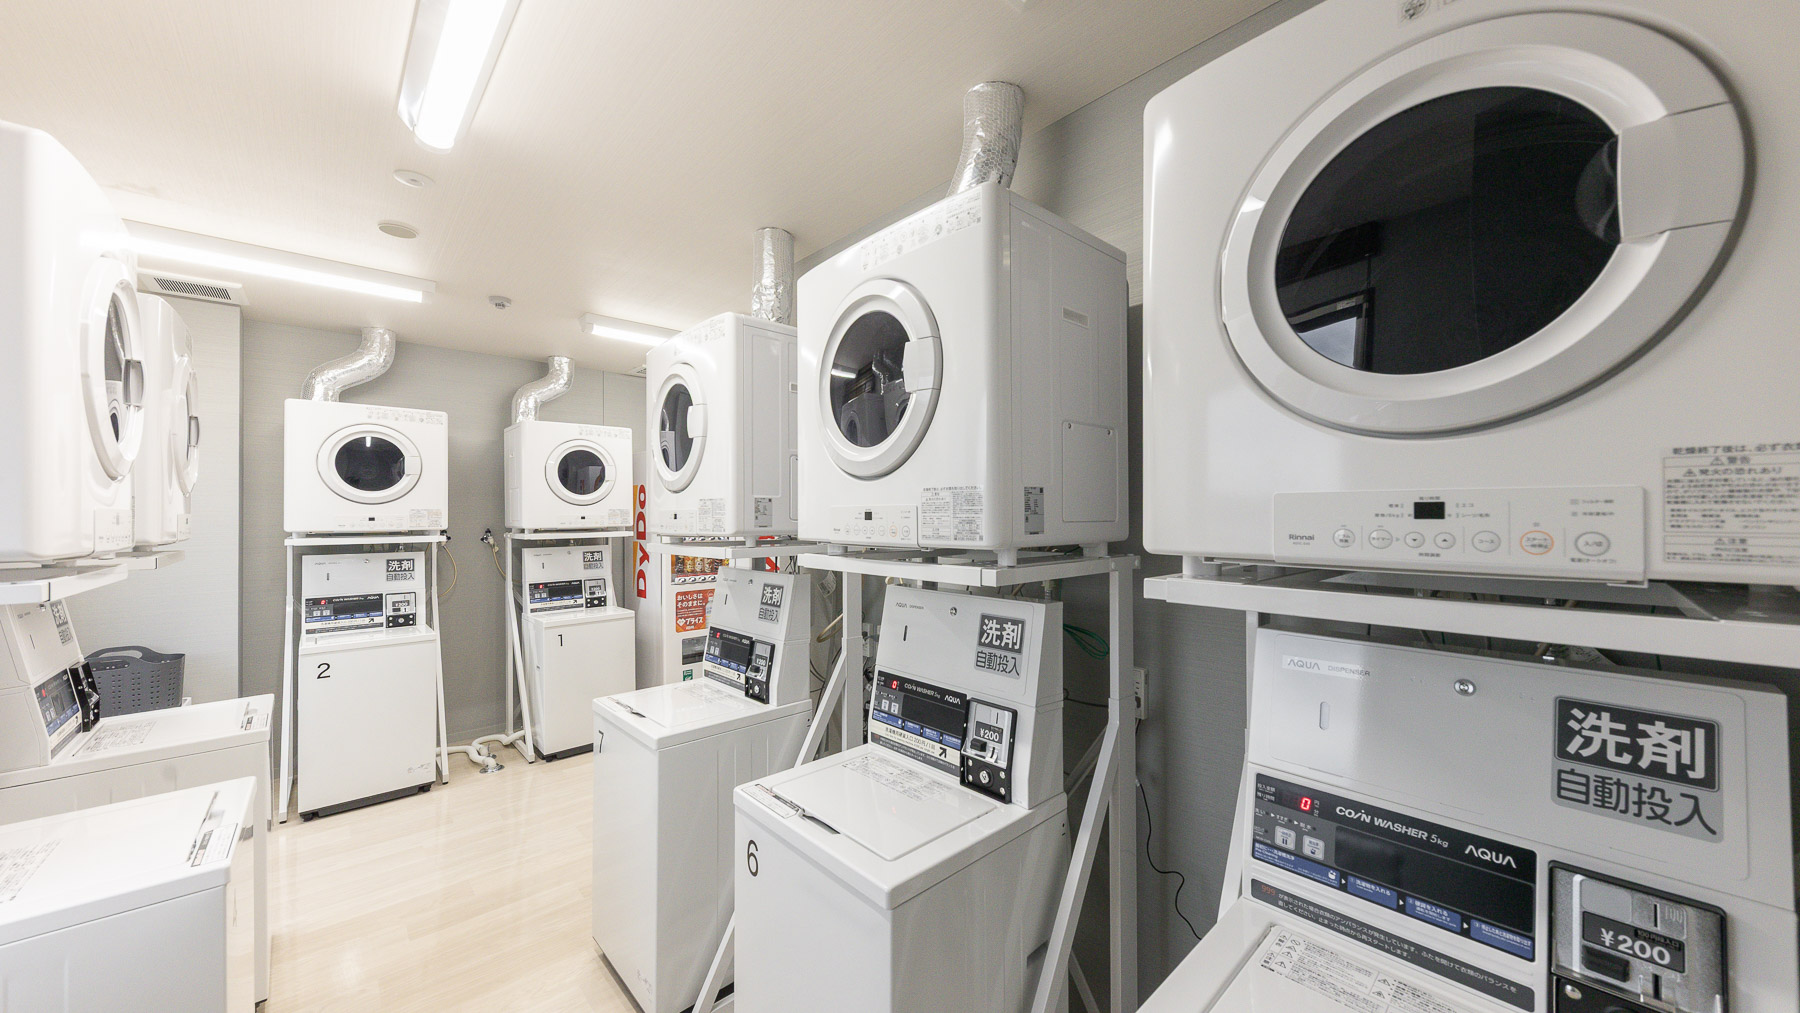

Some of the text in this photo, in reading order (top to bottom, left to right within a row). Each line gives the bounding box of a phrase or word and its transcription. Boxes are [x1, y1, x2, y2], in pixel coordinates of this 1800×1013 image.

[1288, 533, 1315, 541] Rinnai
[584, 551, 602, 561] 洗剤
[388, 560, 413, 571] 洗剤
[387, 573, 414, 581] 自動投入
[677, 593, 703, 601] おいしさは
[761, 586, 782, 606] 洗剤
[677, 600, 706, 608] そのままに。
[685, 616, 703, 625] プライス
[557, 633, 563, 646] 1
[980, 618, 1022, 650] 洗剤
[316, 662, 331, 680] 2
[975, 650, 1020, 677] 自動投入
[1287, 658, 1371, 677] AQUA DISPENSER
[891, 680, 898, 689] 0
[944, 694, 961, 705] AQUA
[598, 729, 604, 753] 7
[980, 727, 1000, 742] ¥200
[1565, 706, 1705, 779] 洗剤
[1300, 796, 1312, 811] 0
[1557, 768, 1717, 836] 自動投入
[1336, 806, 1449, 849] COIN WASHER 5kg
[747, 839, 759, 877] 6
[1465, 845, 1517, 868] AQUA
[1261, 884, 1276, 896] 999
[1600, 927, 1671, 965] ¥200
